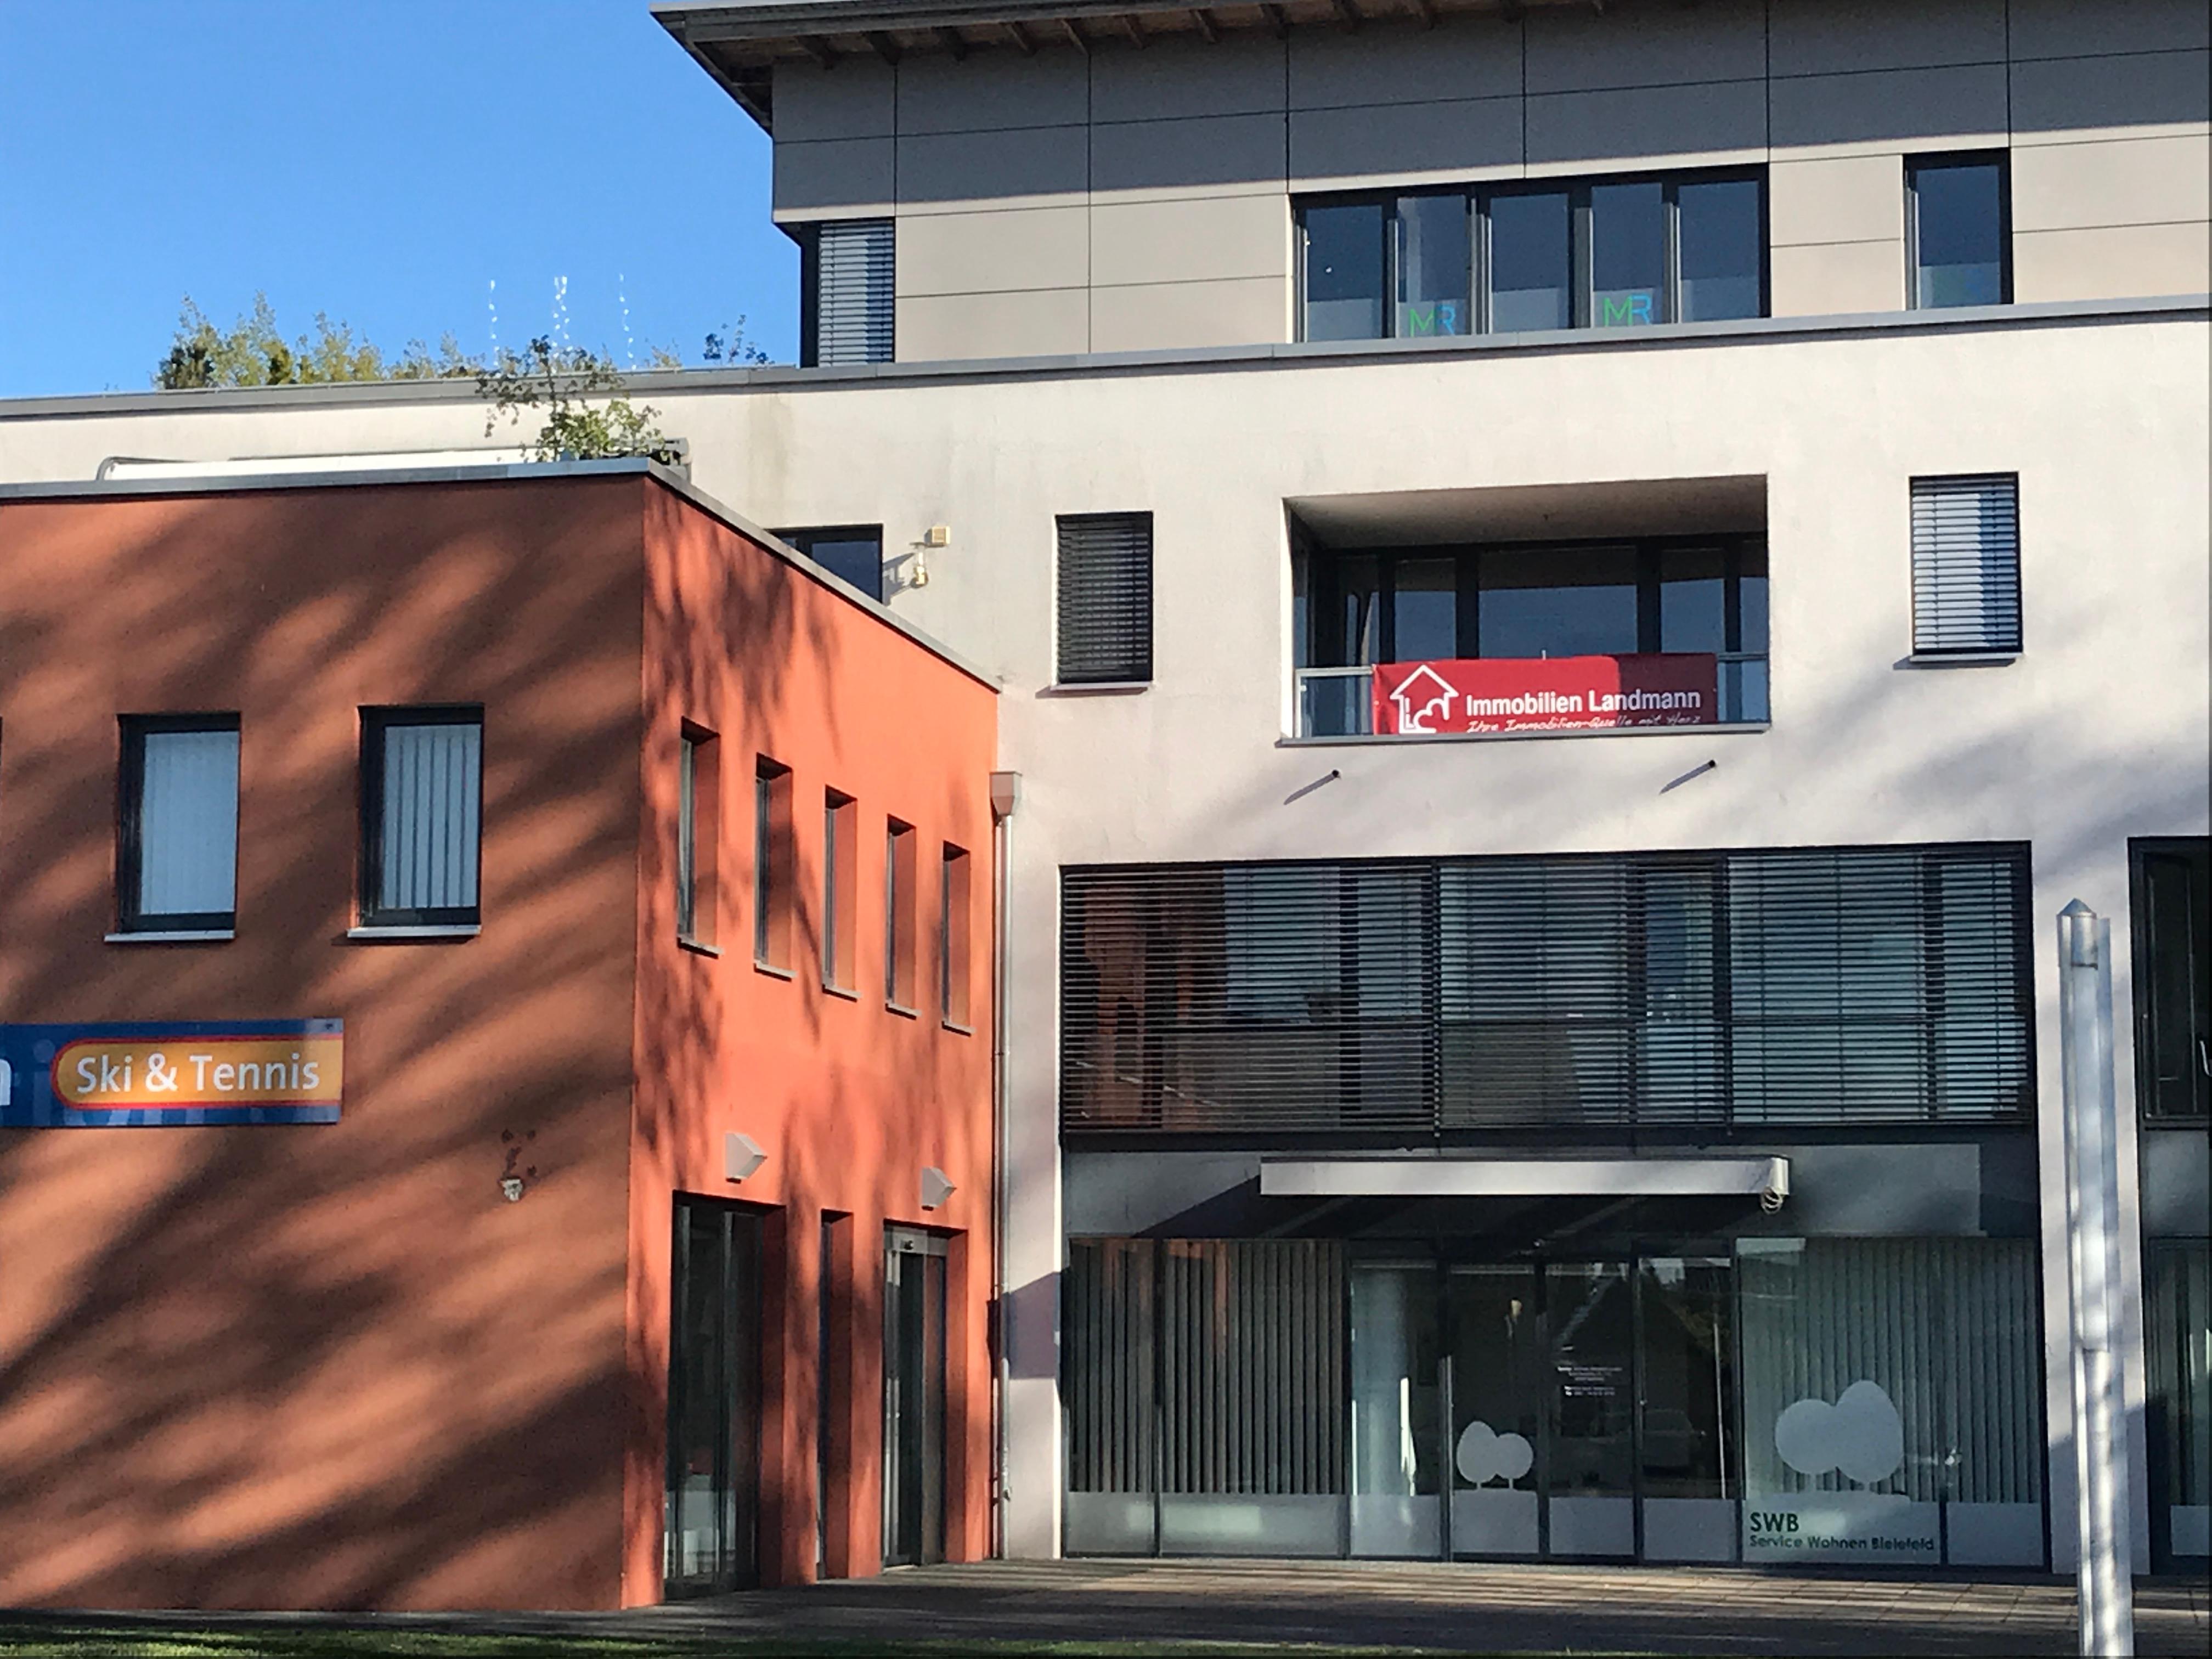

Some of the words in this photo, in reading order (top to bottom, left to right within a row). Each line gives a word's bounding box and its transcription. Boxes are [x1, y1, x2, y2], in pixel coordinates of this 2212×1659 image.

[1604, 292, 1652, 326] MR
[1466, 690, 1582, 716] Immobilien
[1589, 688, 1701, 711] Landmann
[77, 1054, 132, 1094] Ski
[145, 1051, 178, 1092] &
[189, 1052, 320, 1092] Tennis
[1750, 1512, 1799, 1532] SWB
[1750, 1534, 1803, 1548] Service
[1808, 1536, 1867, 1549] Wohnen
[1871, 1537, 1934, 1551] Bielefeld
